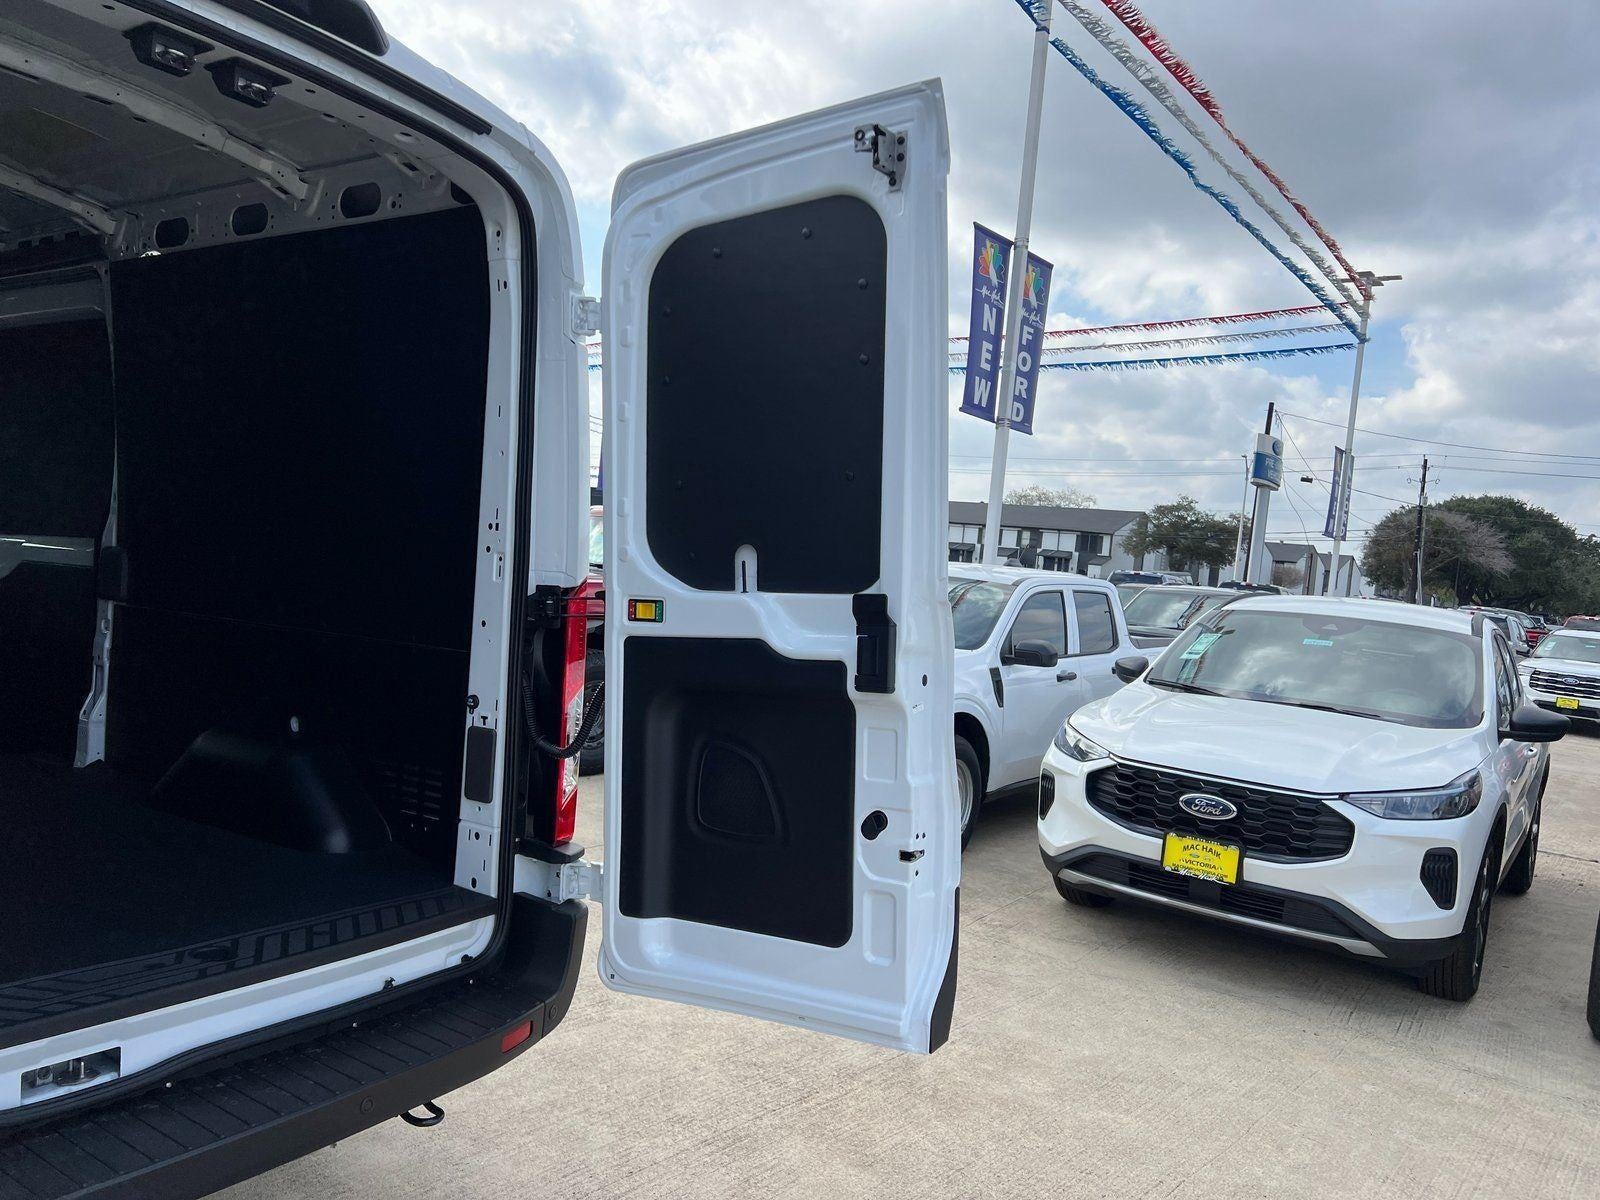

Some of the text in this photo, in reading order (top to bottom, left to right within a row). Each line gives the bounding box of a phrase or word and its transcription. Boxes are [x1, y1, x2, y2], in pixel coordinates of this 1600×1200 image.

[973, 303, 997, 408] NEW
[1012, 324, 1035, 423] FORD
[1191, 798, 1222, 815] Ford
[1182, 843, 1201, 852] MAC
[1202, 845, 1222, 859] HAIK
[1184, 858, 1217, 871] VICTORIA
